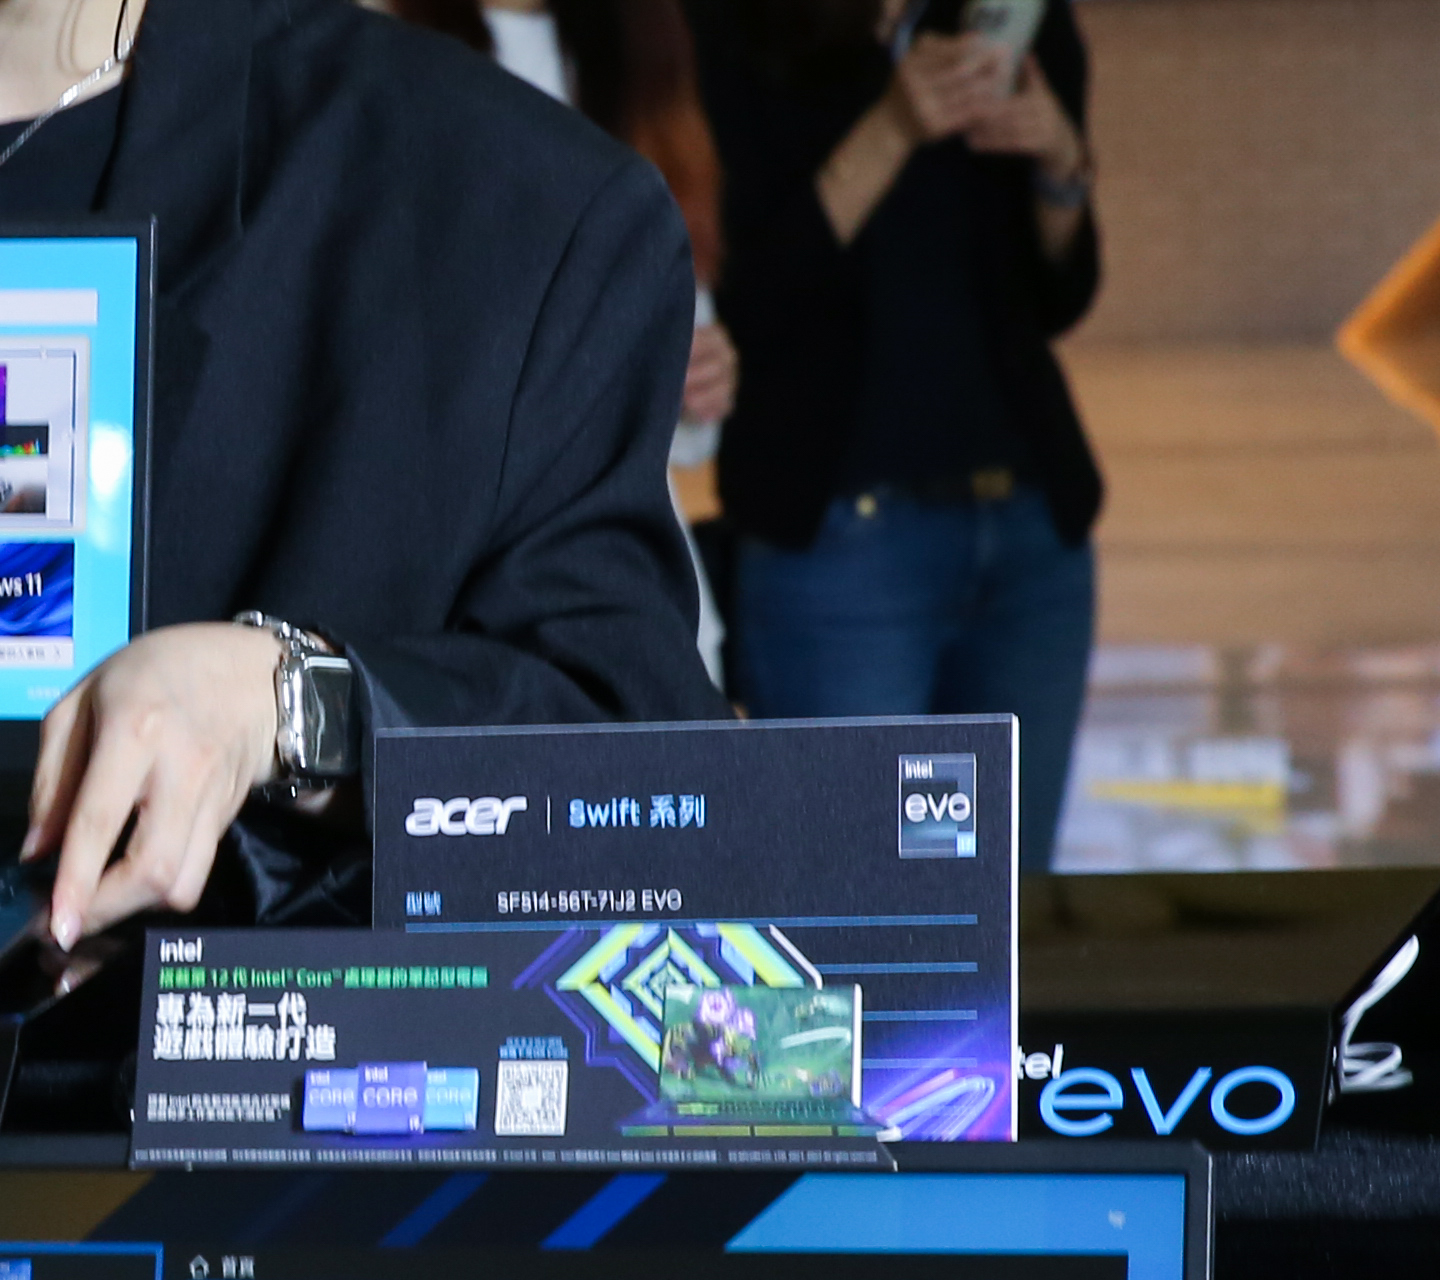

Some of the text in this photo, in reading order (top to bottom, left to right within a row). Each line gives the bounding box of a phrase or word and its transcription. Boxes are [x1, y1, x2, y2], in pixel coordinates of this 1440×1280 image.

[22, 573, 43, 597] 11
[405, 795, 528, 837] acer
[569, 793, 708, 830] Swift 系列
[906, 792, 972, 823] evo
[642, 888, 682, 912] EVO
[160, 937, 202, 962] intel
[157, 992, 307, 1026] 專為新一代
[154, 1023, 336, 1060] 遊戲體驗打造
[1040, 1066, 1295, 1137] evo
